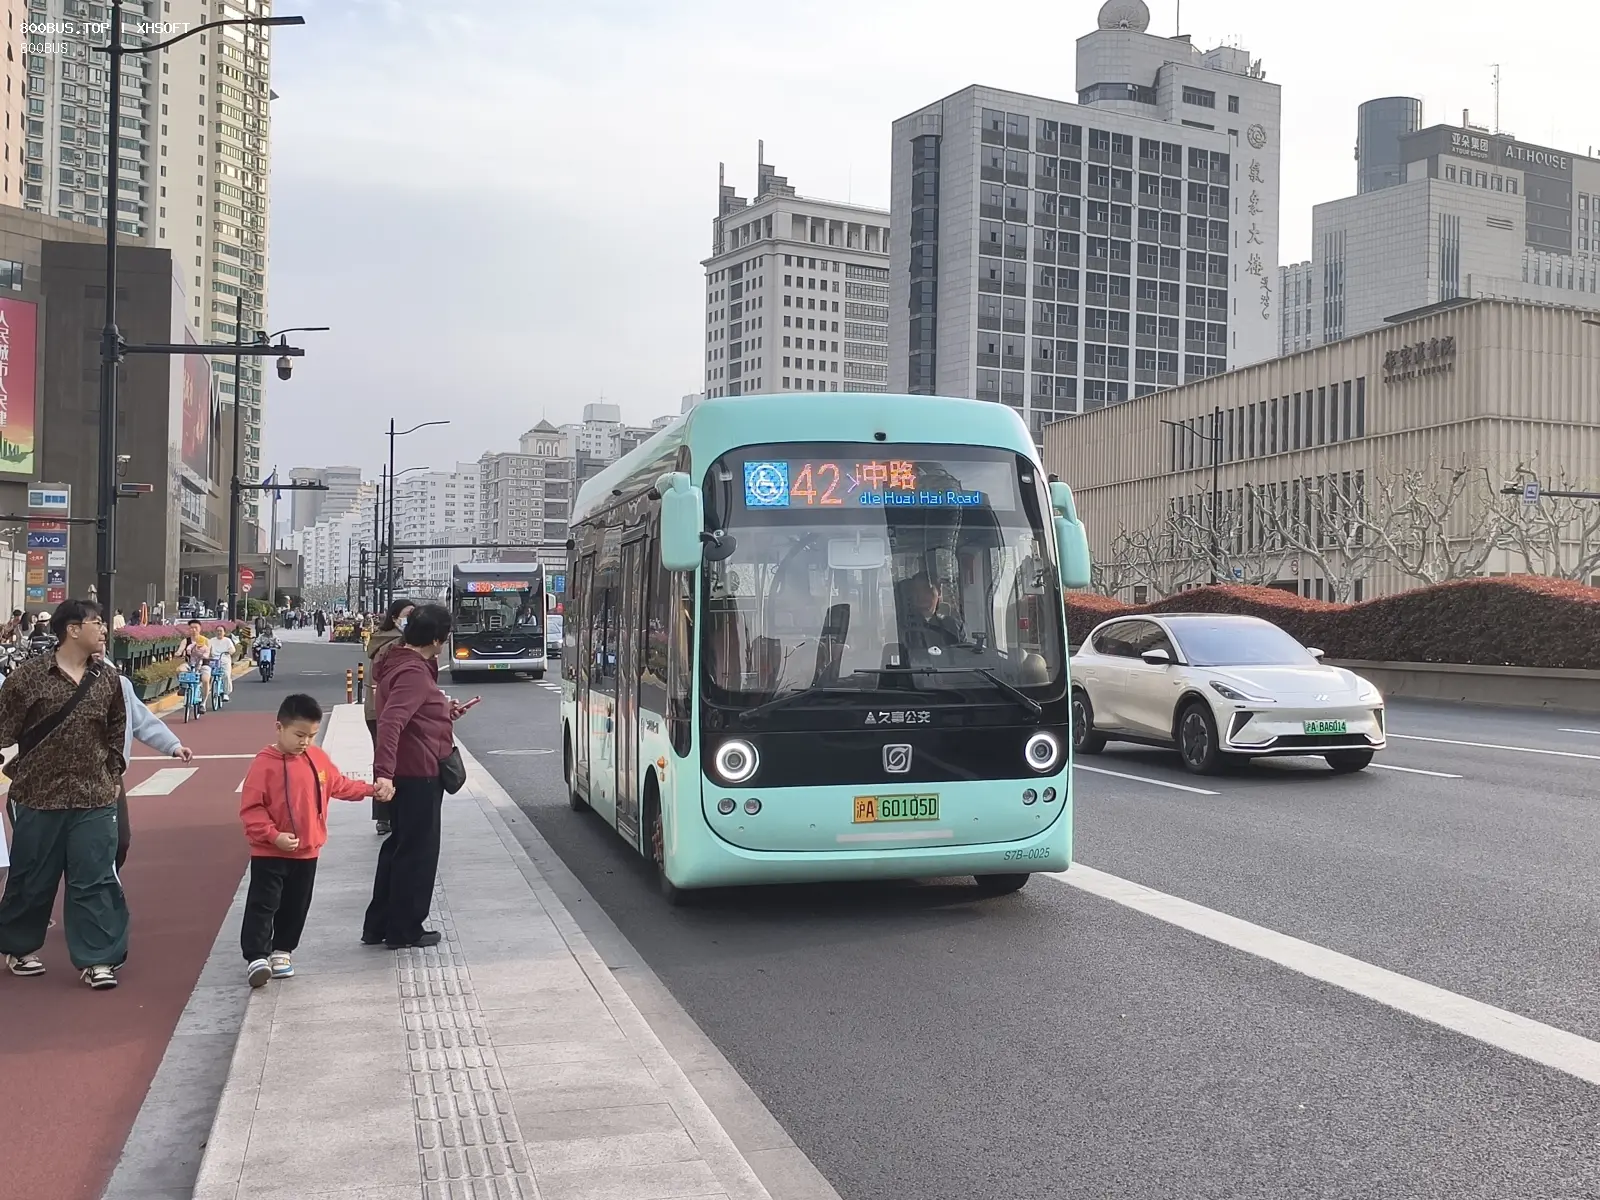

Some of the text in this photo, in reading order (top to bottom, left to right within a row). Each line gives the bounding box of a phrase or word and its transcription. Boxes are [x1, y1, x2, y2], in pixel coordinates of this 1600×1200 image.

[1452, 132, 1489, 152] 亚朵集团
[790, 463, 842, 504] 42
[856, 460, 915, 490] 中路
[859, 491, 981, 505] dle Huai Hai Road
[878, 711, 931, 724] 久事公交
[1003, 848, 1050, 861] S7B-0025
